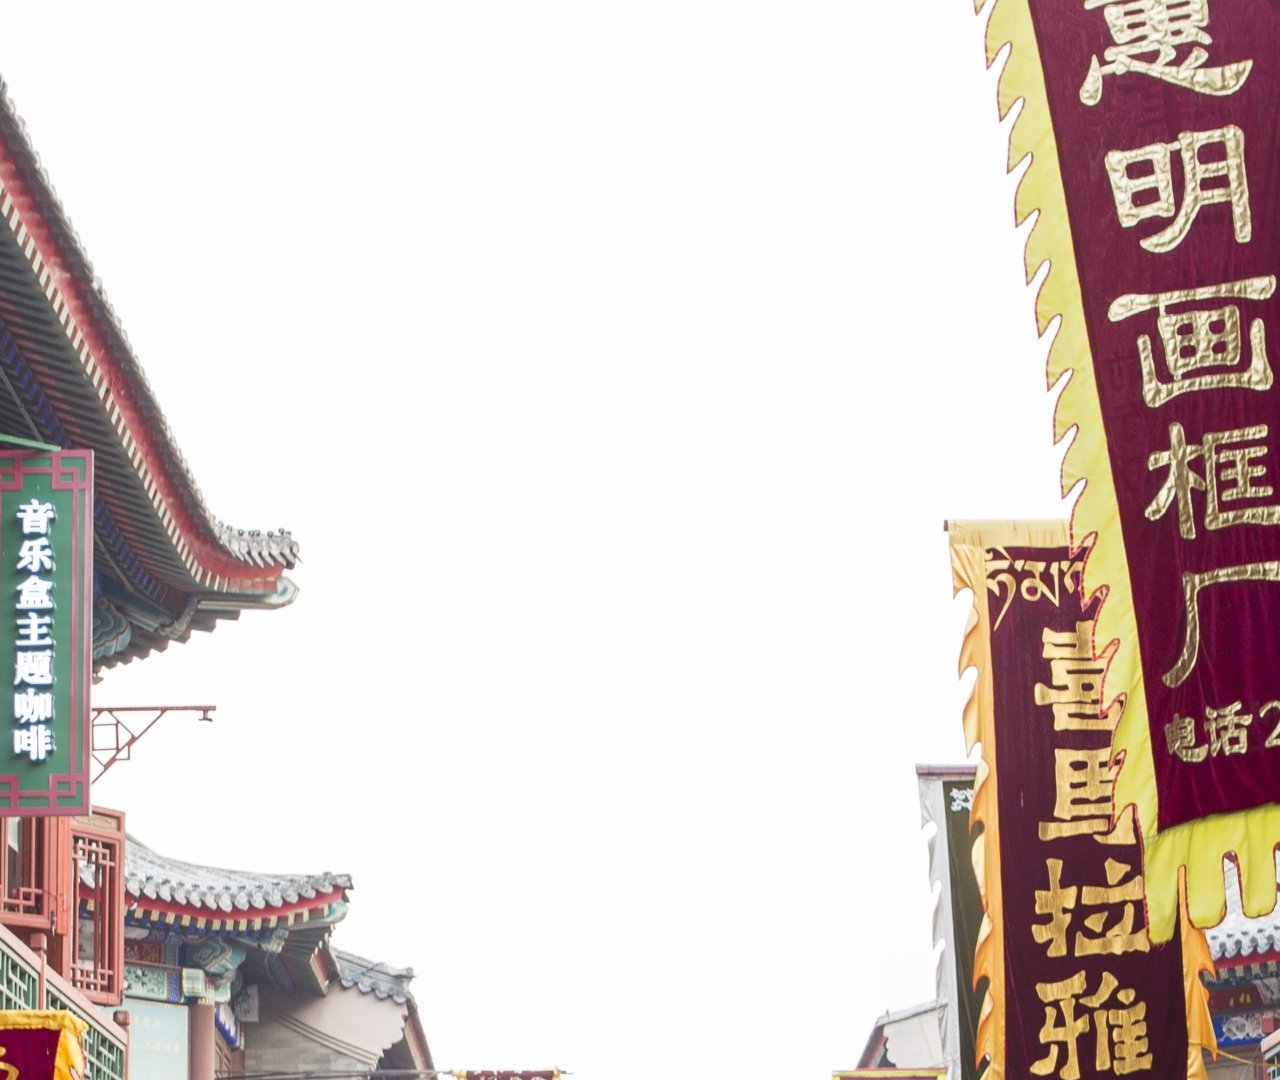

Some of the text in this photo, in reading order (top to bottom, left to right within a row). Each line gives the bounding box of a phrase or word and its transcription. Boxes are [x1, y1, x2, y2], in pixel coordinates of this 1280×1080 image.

[13, 499, 55, 760] 音乐盒主题咖啡
[1163, 701, 1252, 763] 电话
